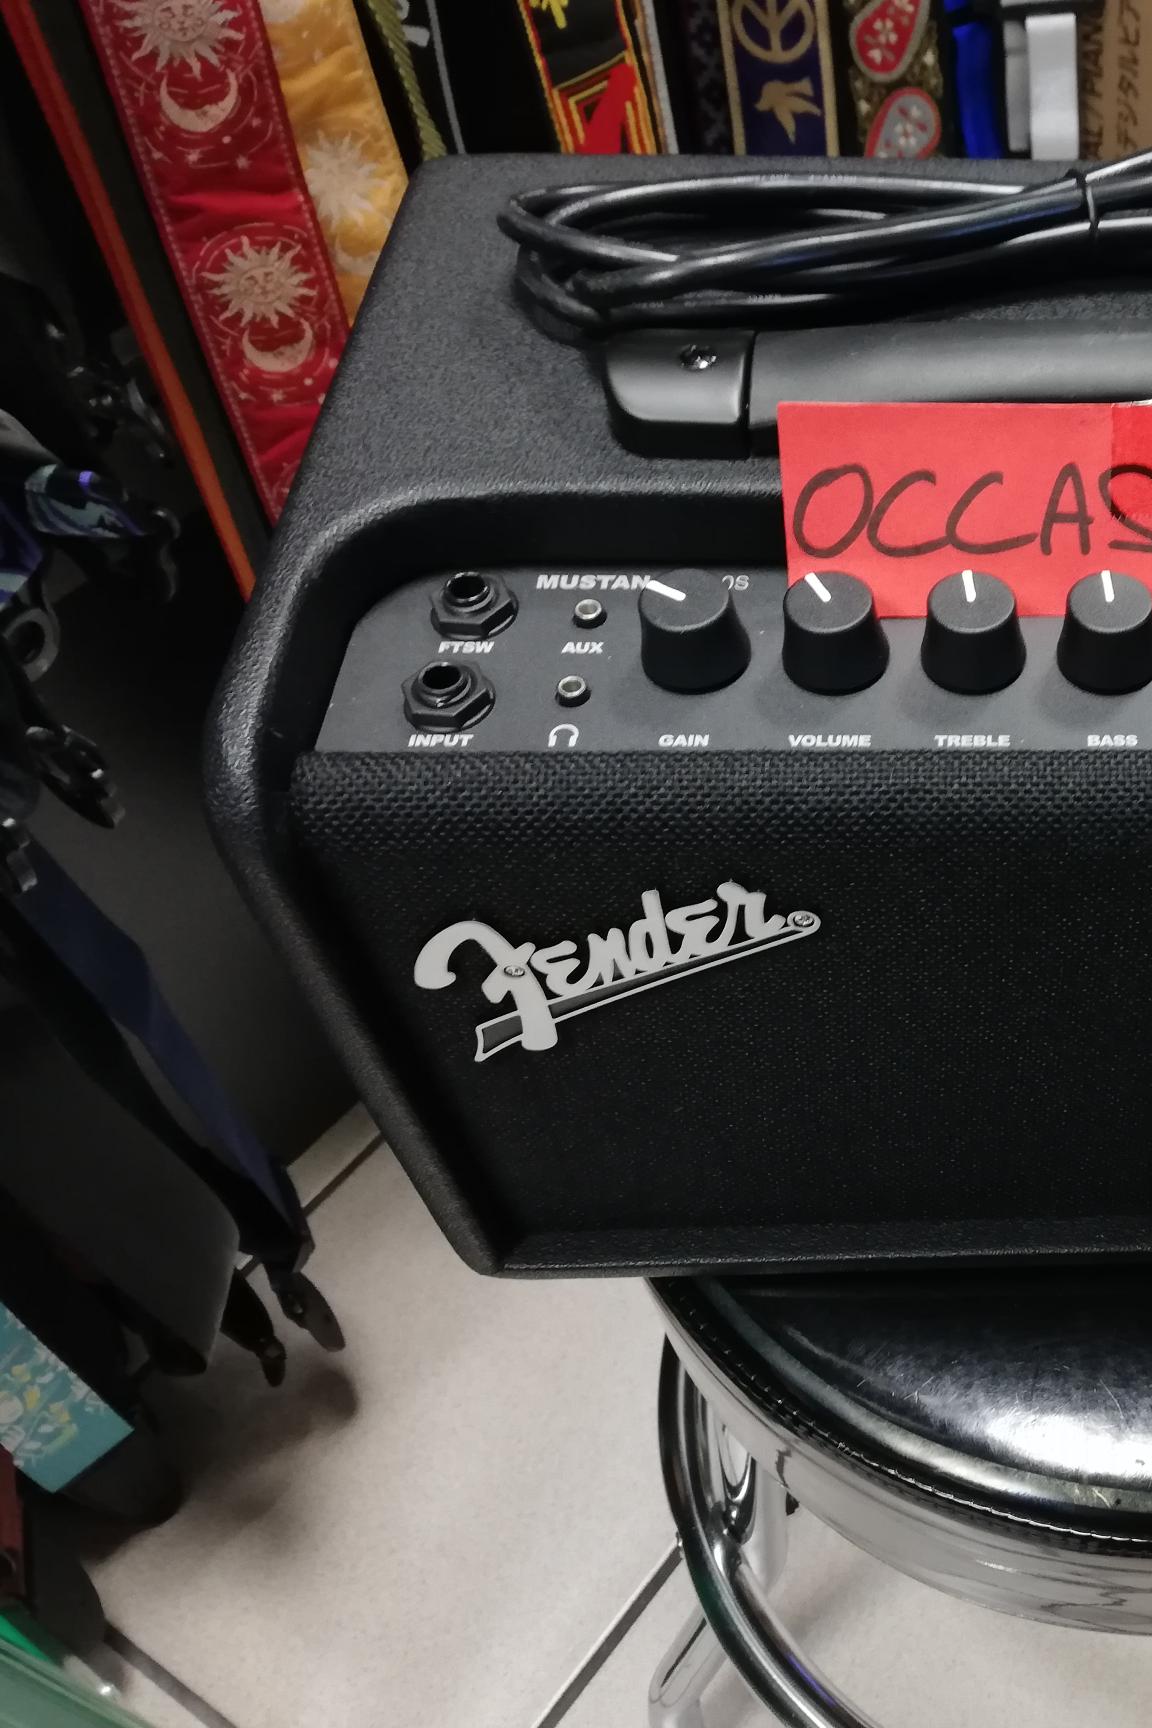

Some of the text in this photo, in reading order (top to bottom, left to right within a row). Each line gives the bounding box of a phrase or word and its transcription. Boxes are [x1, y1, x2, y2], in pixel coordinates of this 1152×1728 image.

[535, 573, 650, 591] MUSTAN
[437, 641, 495, 655] FTSW
[561, 641, 604, 655] AUX
[407, 734, 474, 748] INPUT
[658, 734, 709, 748] GAIN
[788, 734, 872, 748] VOLUME
[934, 734, 1011, 748] TREBLE
[1086, 734, 1139, 748] BASS
[413, 880, 787, 1052] Fender
